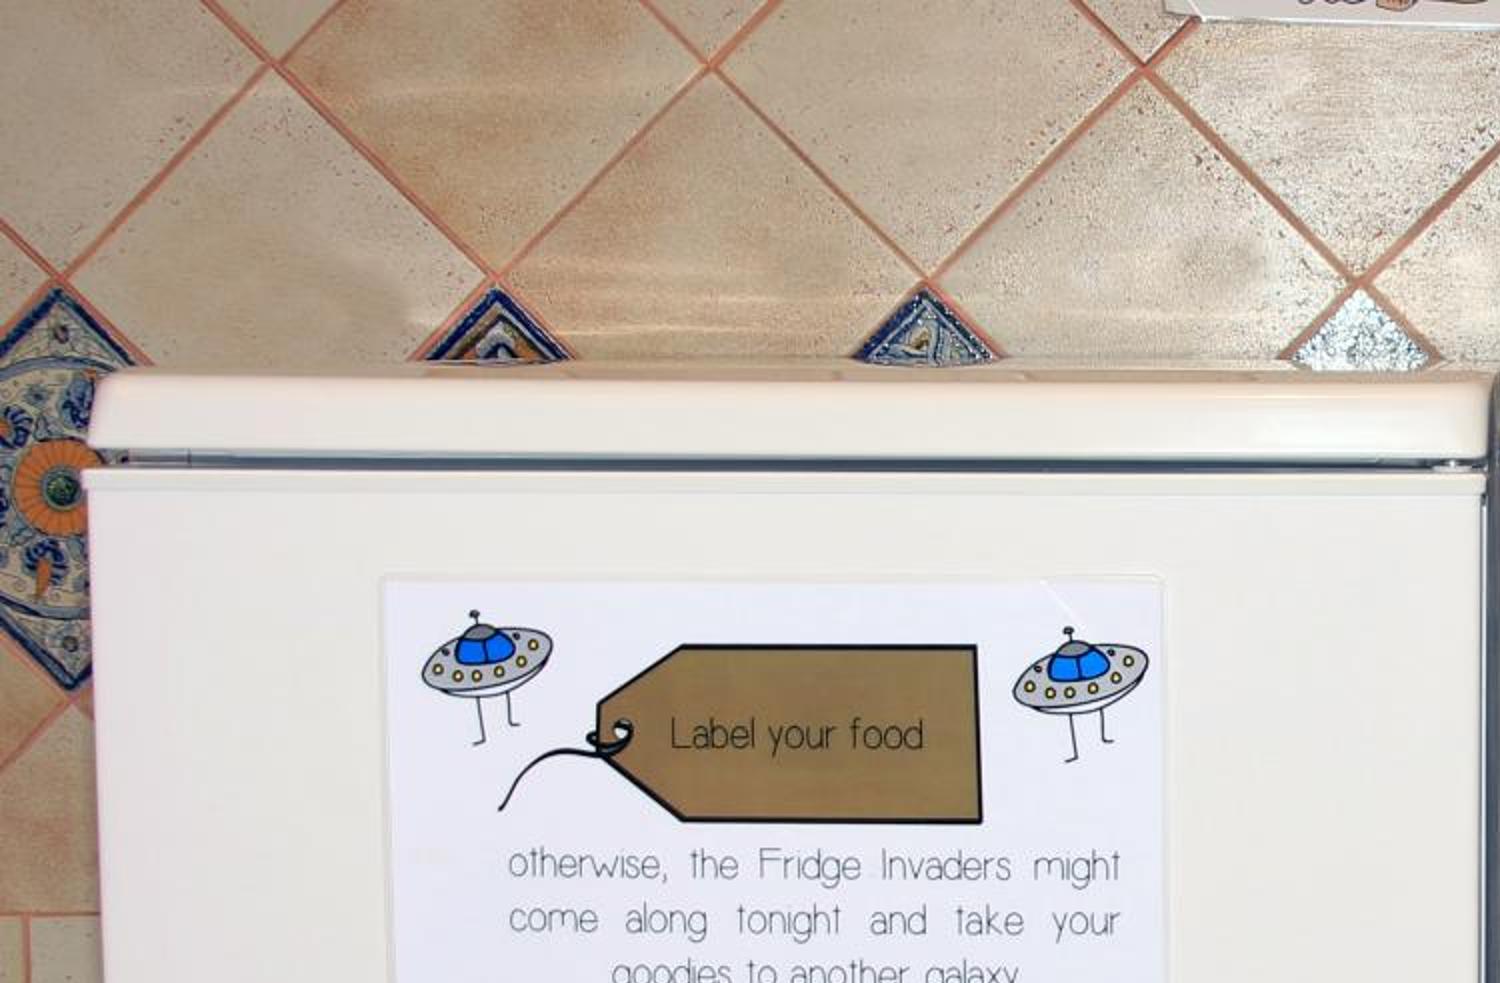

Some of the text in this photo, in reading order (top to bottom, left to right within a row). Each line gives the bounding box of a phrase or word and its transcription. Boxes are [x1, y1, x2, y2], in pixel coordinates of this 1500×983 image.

[671, 717, 924, 758] Label your food
[509, 845, 1120, 889] otherwise, the Fridge Invaders might
[509, 903, 1120, 944] come along tonight and take your
